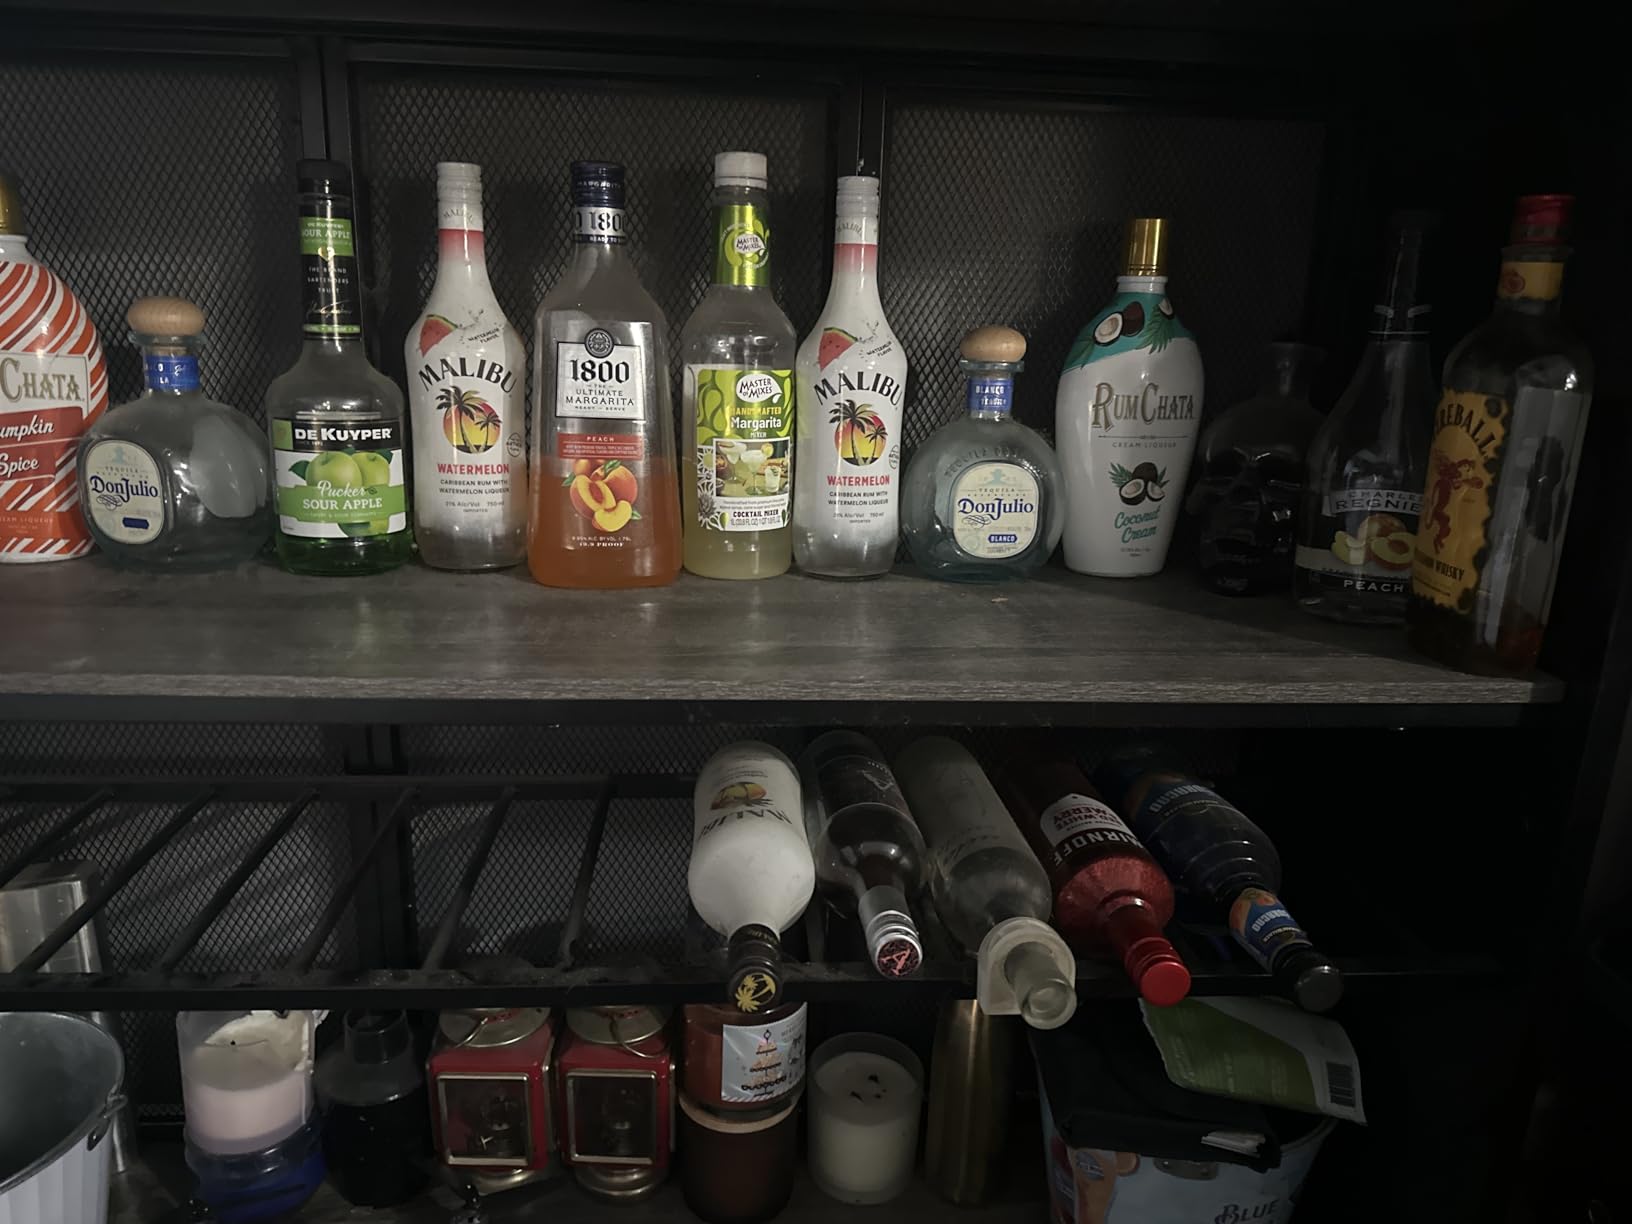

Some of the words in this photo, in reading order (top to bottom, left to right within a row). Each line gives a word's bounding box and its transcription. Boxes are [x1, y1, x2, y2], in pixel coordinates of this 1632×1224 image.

[323, 266, 346, 274] BAND
[418, 357, 517, 393] MALIBU
[570, 360, 629, 383] 1800
[575, 388, 624, 397] ULTIMATE
[740, 378, 772, 393] MASTER
[749, 386, 772, 398] MIXES
[814, 371, 903, 406] MALIBU
[565, 396, 634, 405] MARGARITA
[731, 416, 782, 431] Margarita
[294, 428, 319, 440] DE
[320, 427, 393, 441] KUYPER
[437, 463, 510, 475] WATERMELON
[827, 475, 890, 487] WATERMELON
[317, 480, 367, 498] Pucker
[1349, 491, 1416, 500] CHARLE
[303, 498, 340, 511] SOUR
[342, 497, 382, 511] APPLE
[1335, 500, 1420, 513] REGNIE
[1114, 504, 1161, 529] Coconut
[1121, 526, 1157, 543] Cream
[1435, 559, 1465, 582] WHISKY
[1344, 580, 1404, 593] PEACH
[1052, 830, 1144, 867] MIRNOFF
